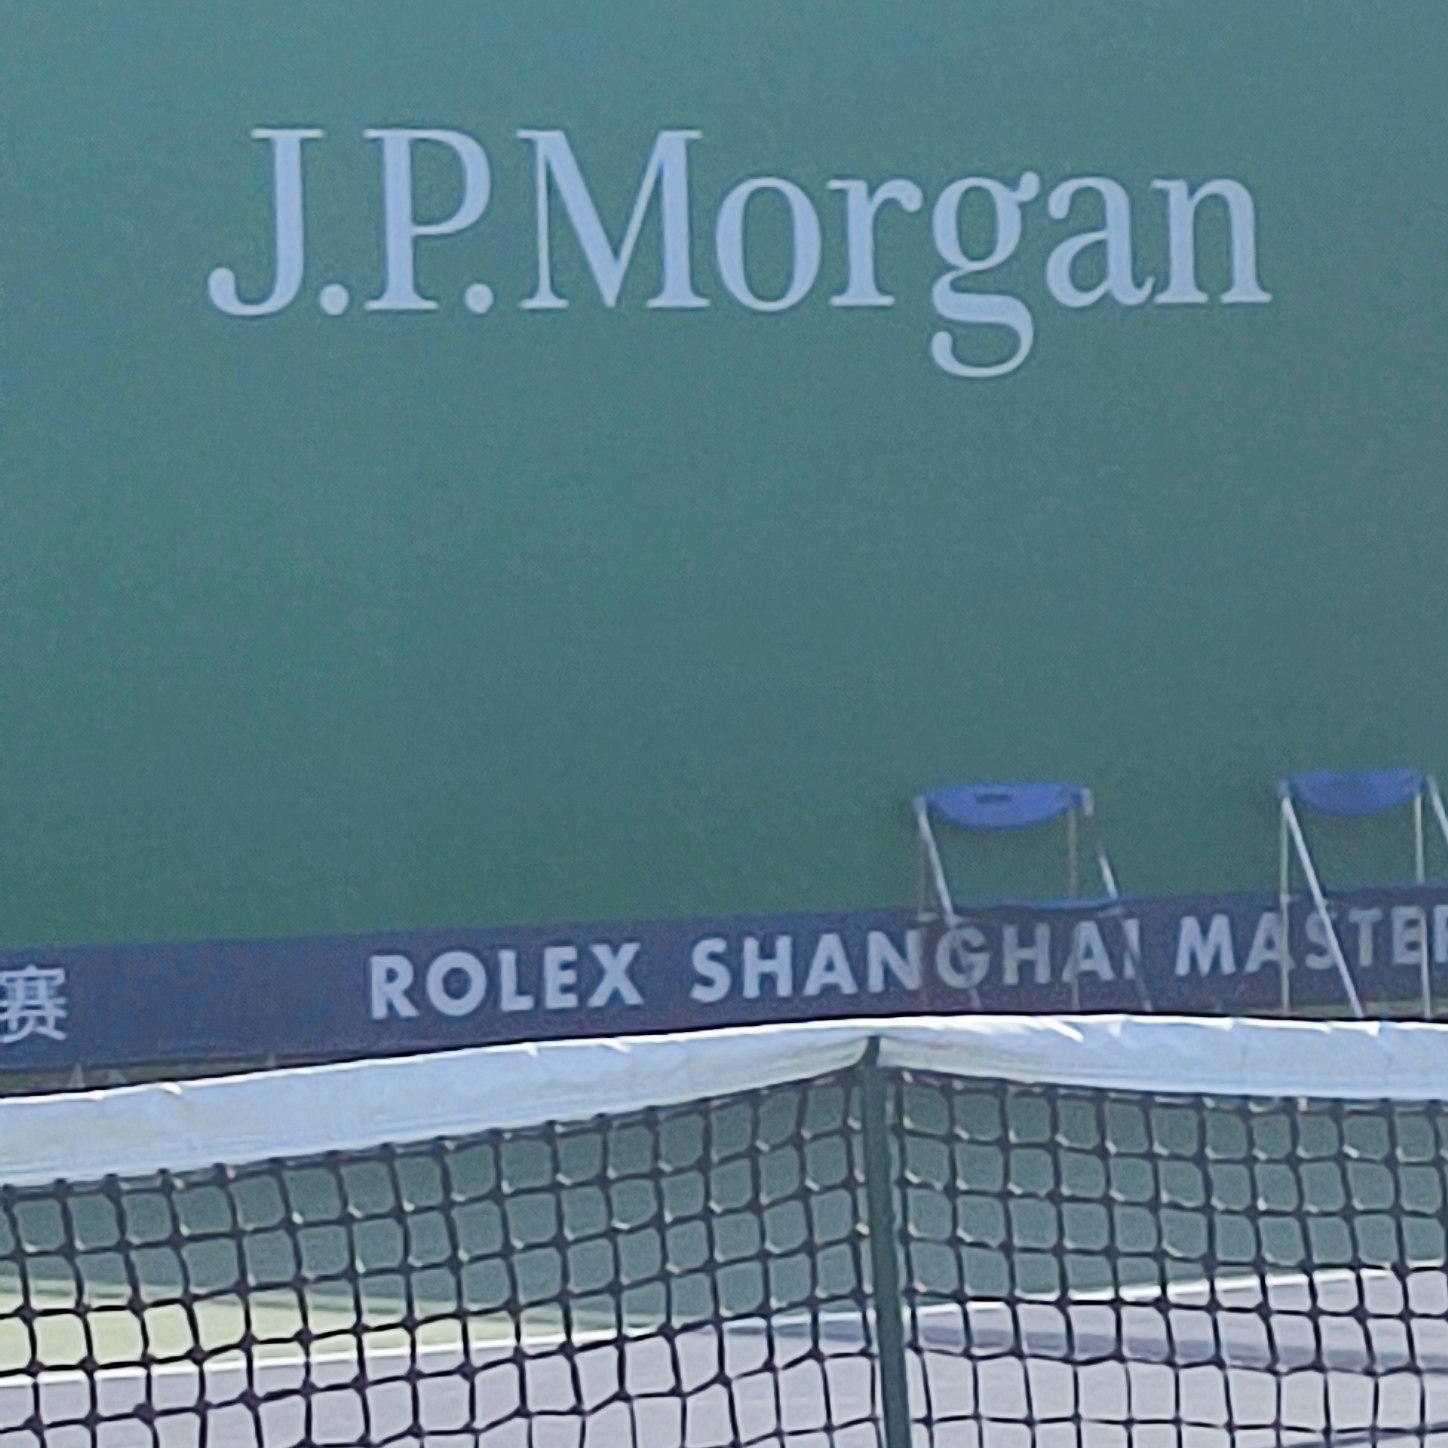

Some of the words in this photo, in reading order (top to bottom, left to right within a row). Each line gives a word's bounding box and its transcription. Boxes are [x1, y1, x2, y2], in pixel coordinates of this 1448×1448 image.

[208, 127, 1272, 378] J.P.Morgan
[370, 943, 645, 1019] ROLEX
[691, 918, 1141, 1003] SHANGHAI
